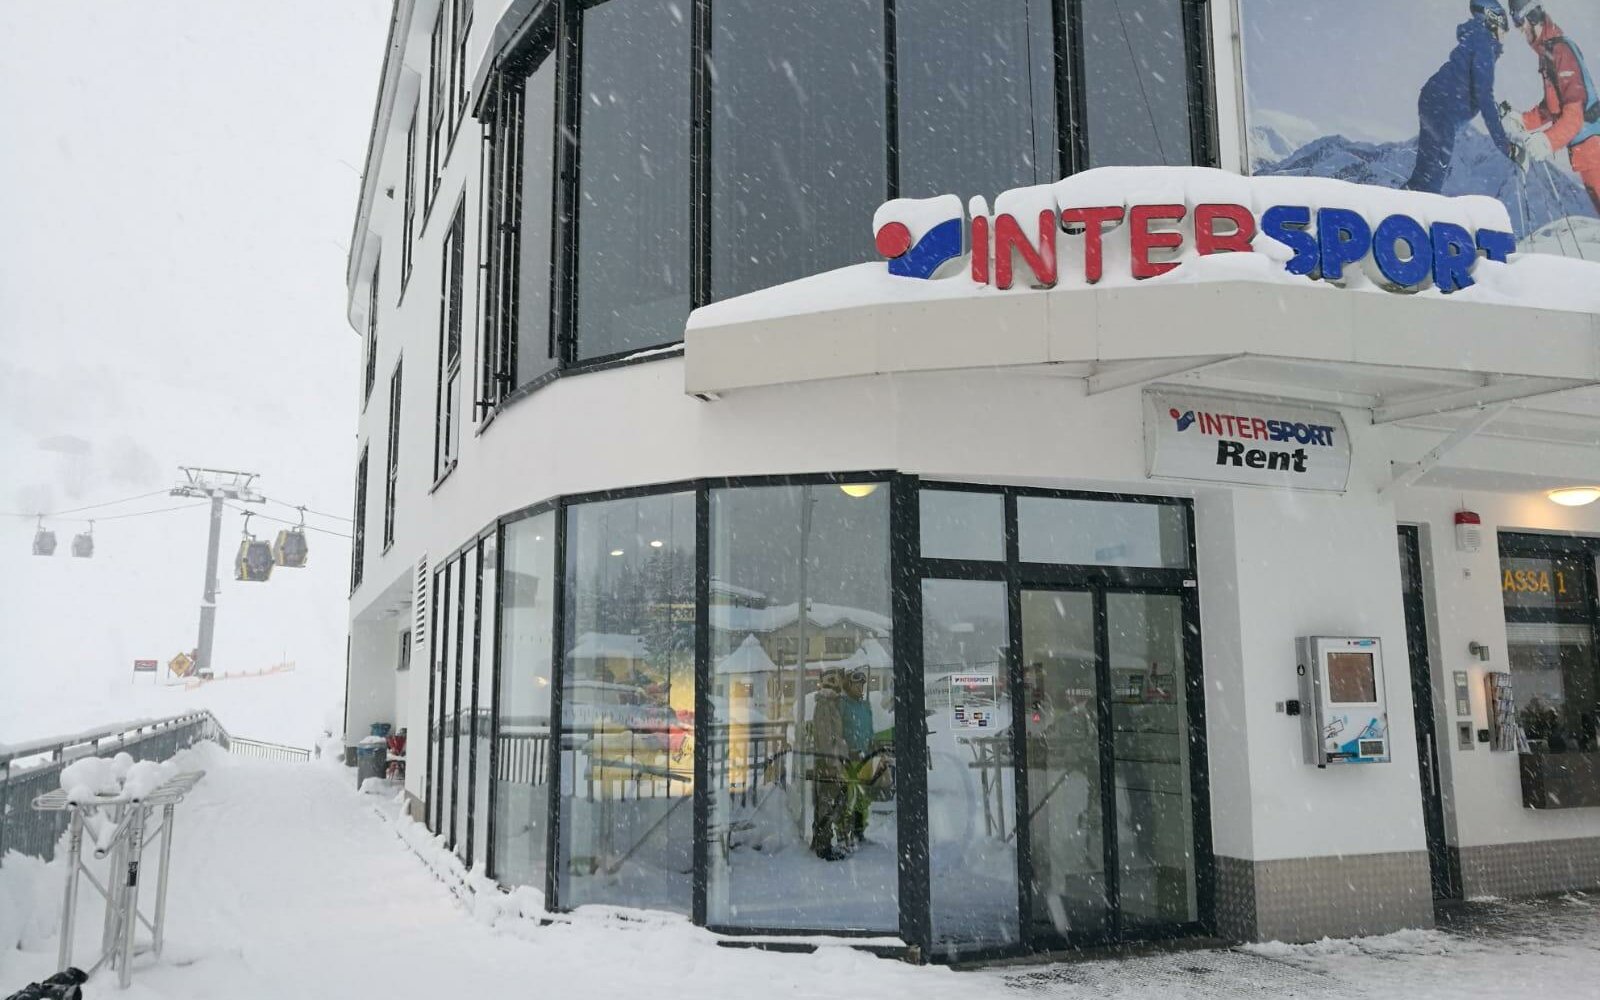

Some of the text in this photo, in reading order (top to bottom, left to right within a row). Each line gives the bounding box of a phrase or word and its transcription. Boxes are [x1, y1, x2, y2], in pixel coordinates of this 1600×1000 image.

[971, 203, 1517, 293] INTERSPORT
[1197, 411, 1336, 446] INTERSPORT
[1216, 440, 1308, 473] Rent
[1503, 569, 1567, 594] ASSA 1
